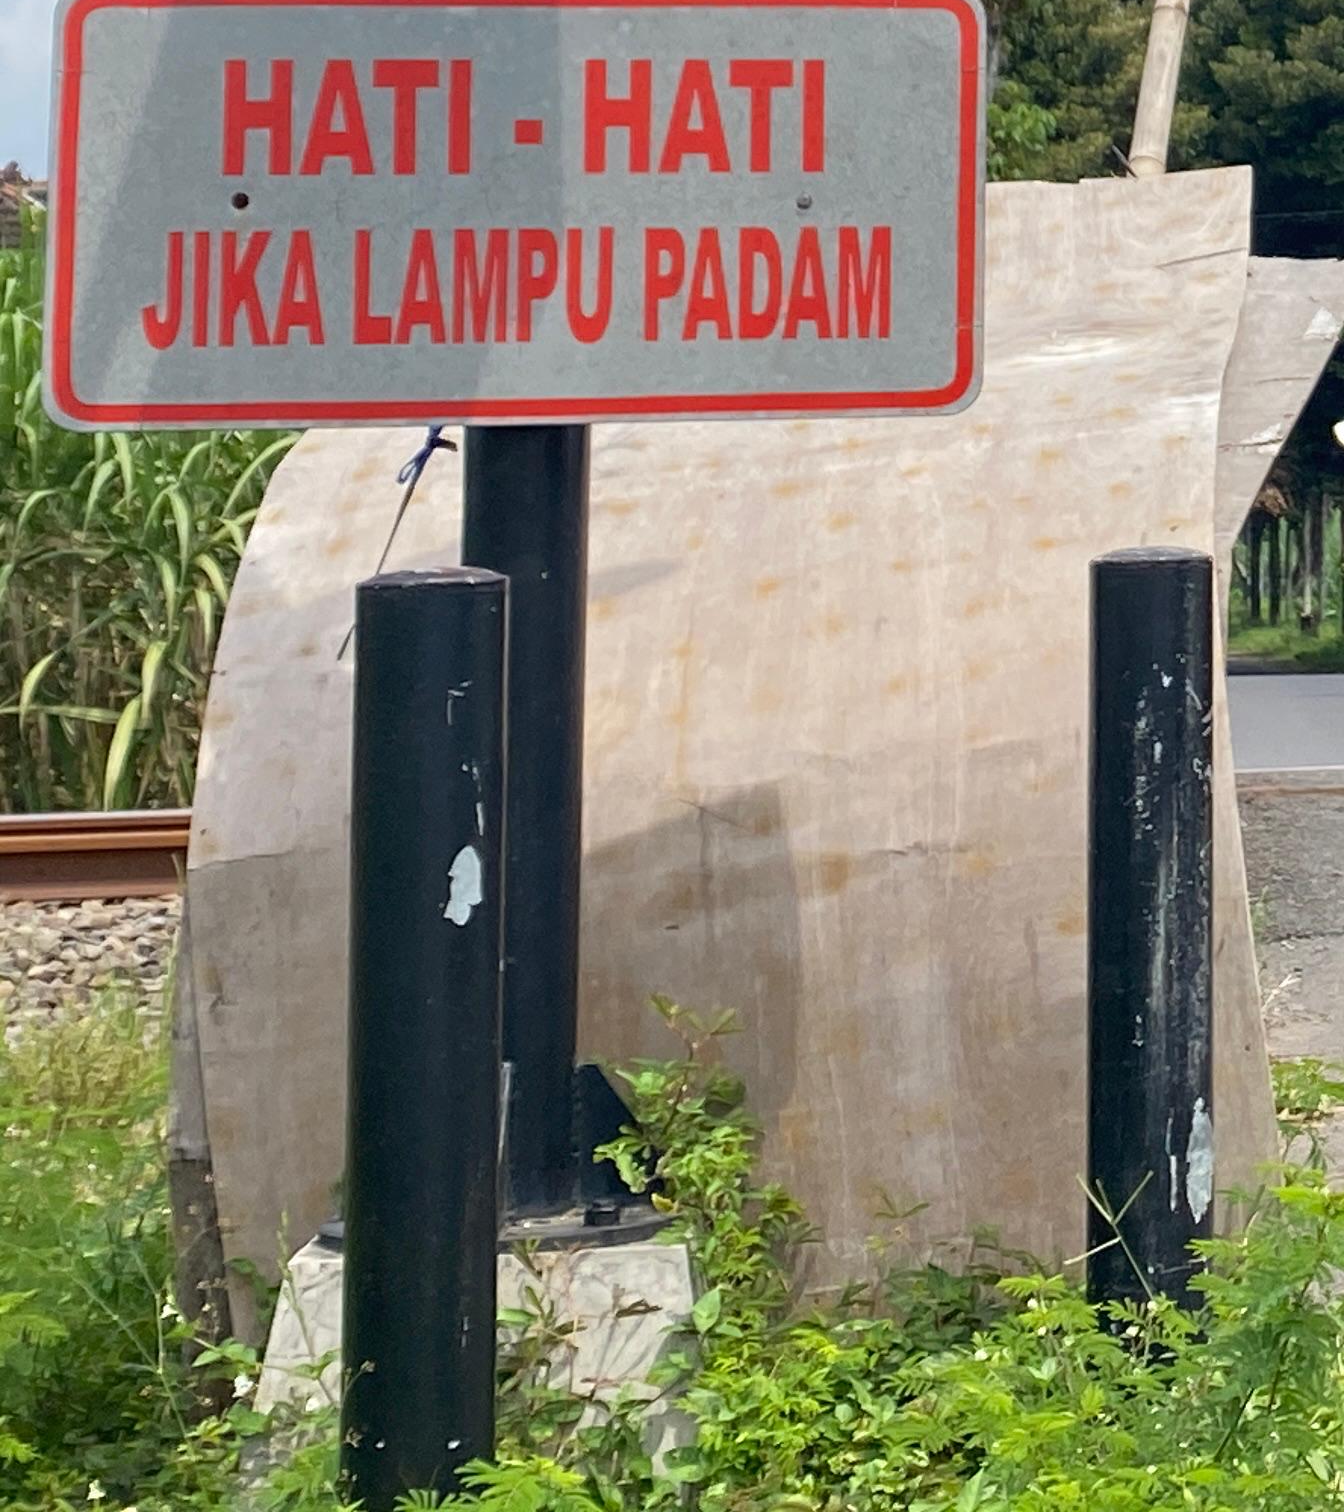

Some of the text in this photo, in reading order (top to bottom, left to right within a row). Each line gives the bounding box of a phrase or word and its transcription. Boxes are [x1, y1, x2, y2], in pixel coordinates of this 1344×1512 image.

[223, 59, 473, 176] HATI
[584, 59, 826, 174] HATI
[142, 226, 892, 350] JIKA LAMPU PADAM
